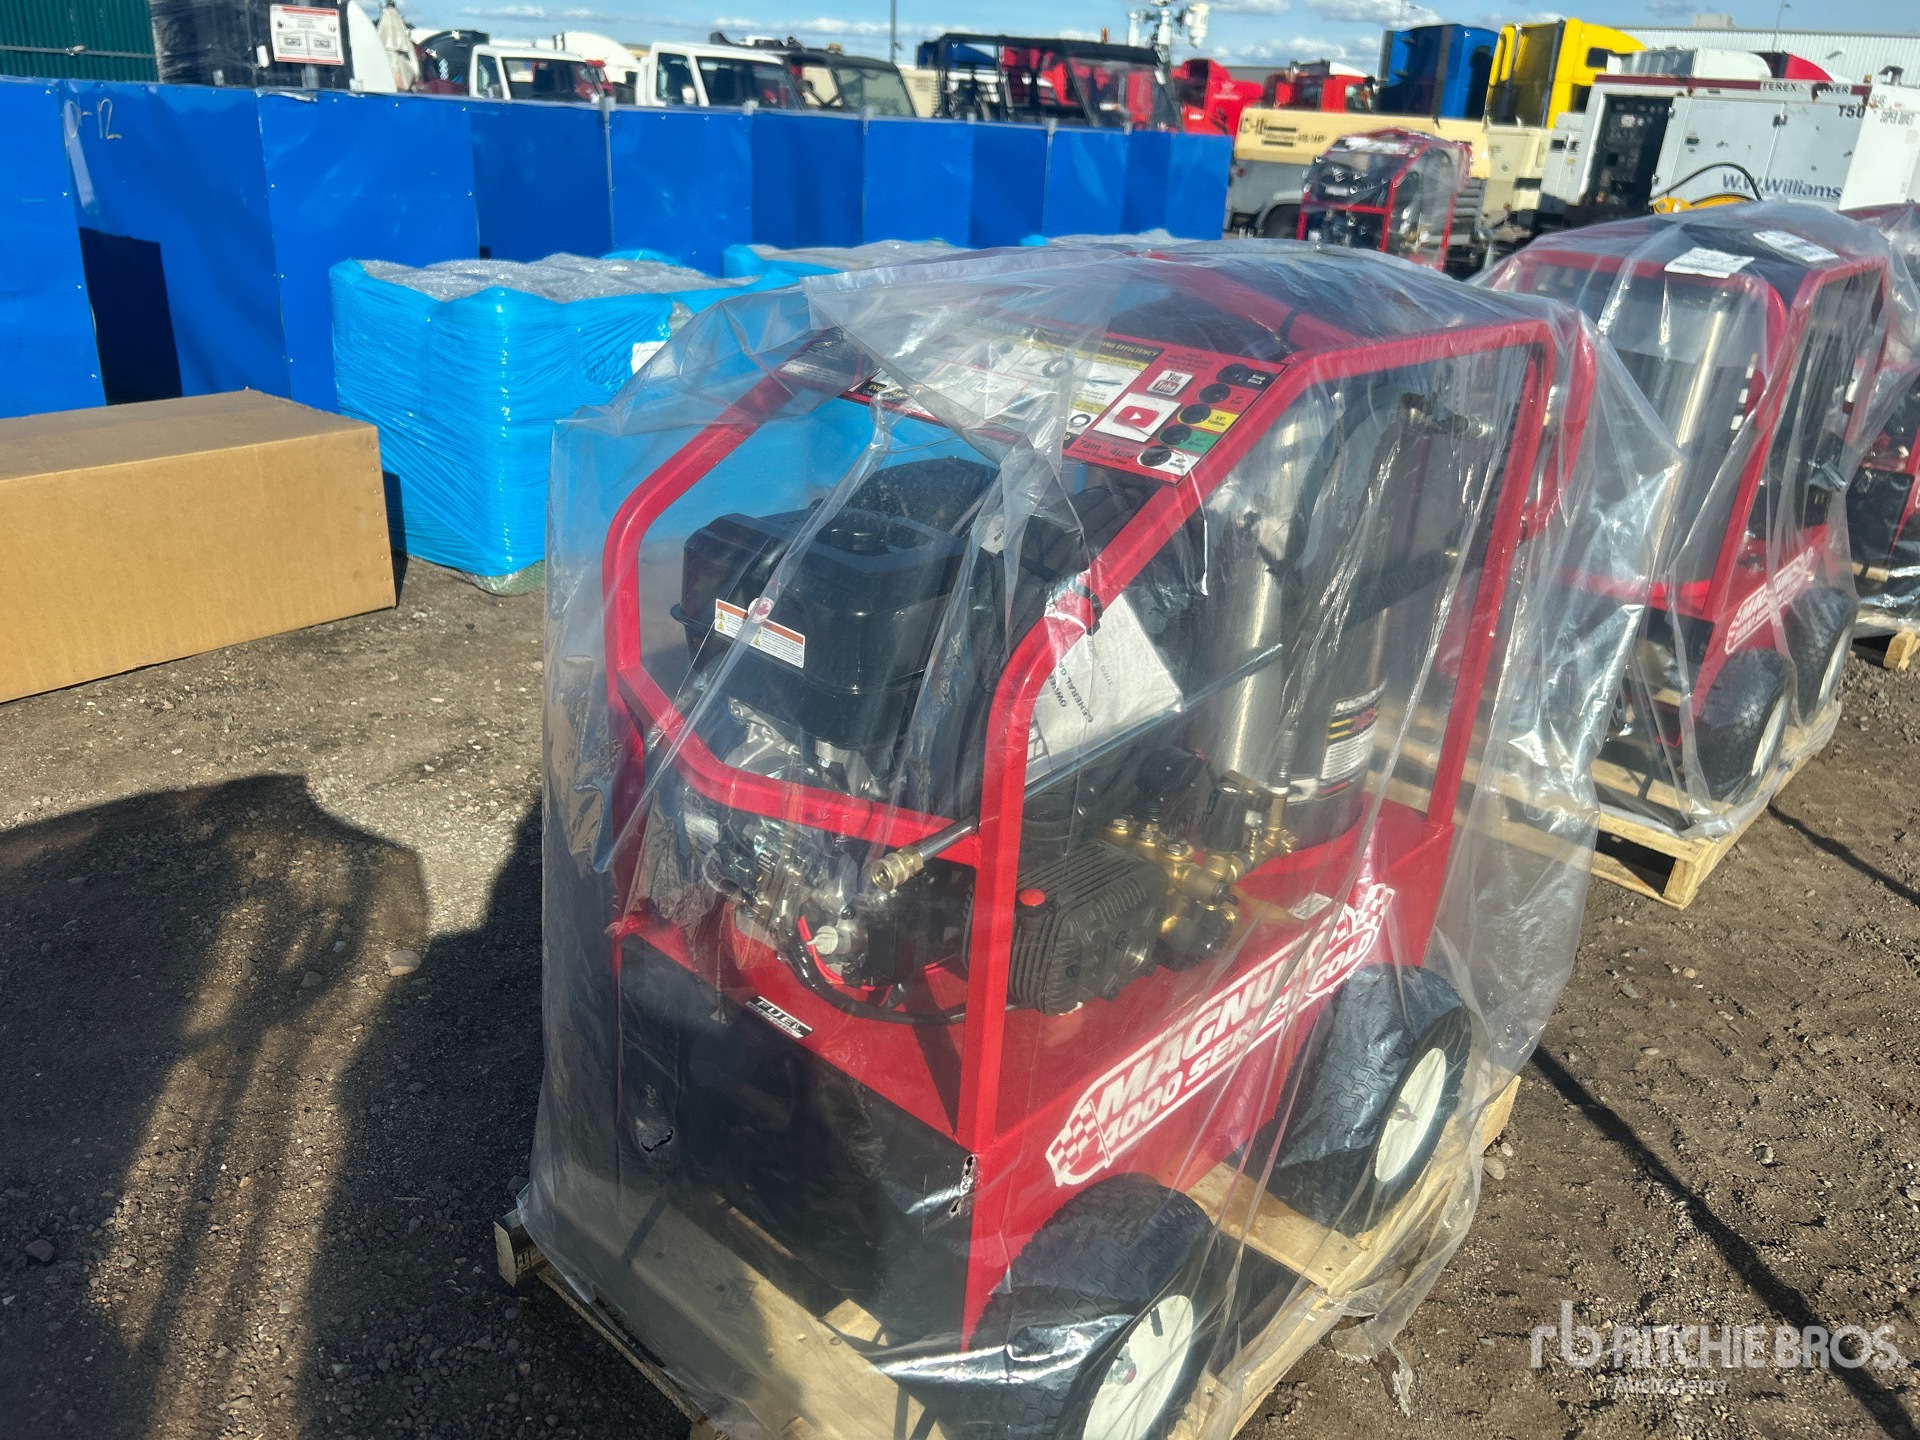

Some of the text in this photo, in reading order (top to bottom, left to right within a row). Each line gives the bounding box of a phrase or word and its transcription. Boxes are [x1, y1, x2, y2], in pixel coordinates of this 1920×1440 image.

[1763, 82, 1797, 93] TEREX
[1166, 371, 1183, 382] You
[1155, 380, 1179, 393] Tube
[1311, 937, 1372, 989] GOLD
